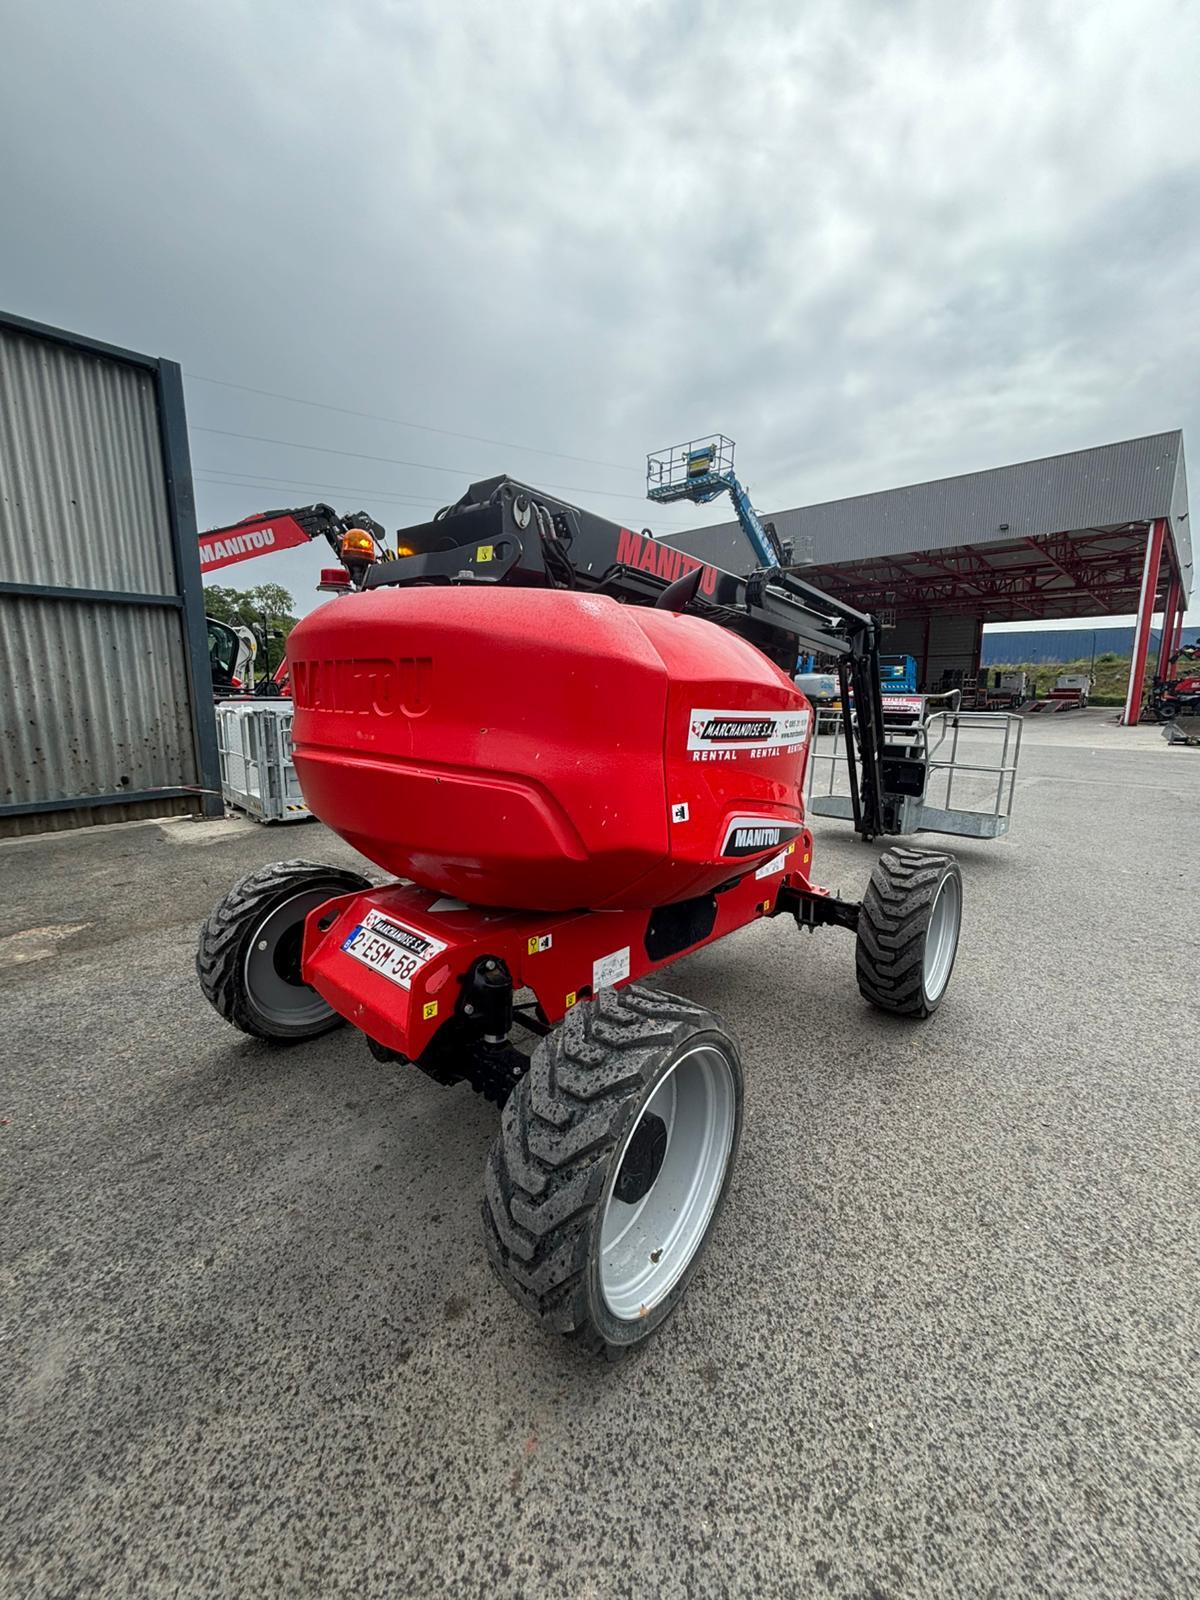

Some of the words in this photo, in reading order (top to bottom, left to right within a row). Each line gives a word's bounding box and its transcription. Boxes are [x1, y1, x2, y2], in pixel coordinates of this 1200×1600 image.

[199, 528, 275, 564] MANITOU
[704, 721, 760, 737] MARCHANDISE
[693, 750, 737, 761] RENTAL
[750, 747, 780, 759] RENTAL
[734, 829, 780, 847] MANITOU
[375, 920, 417, 948] MARCHANDISE
[350, 932, 417, 980] 2-ESM-58
